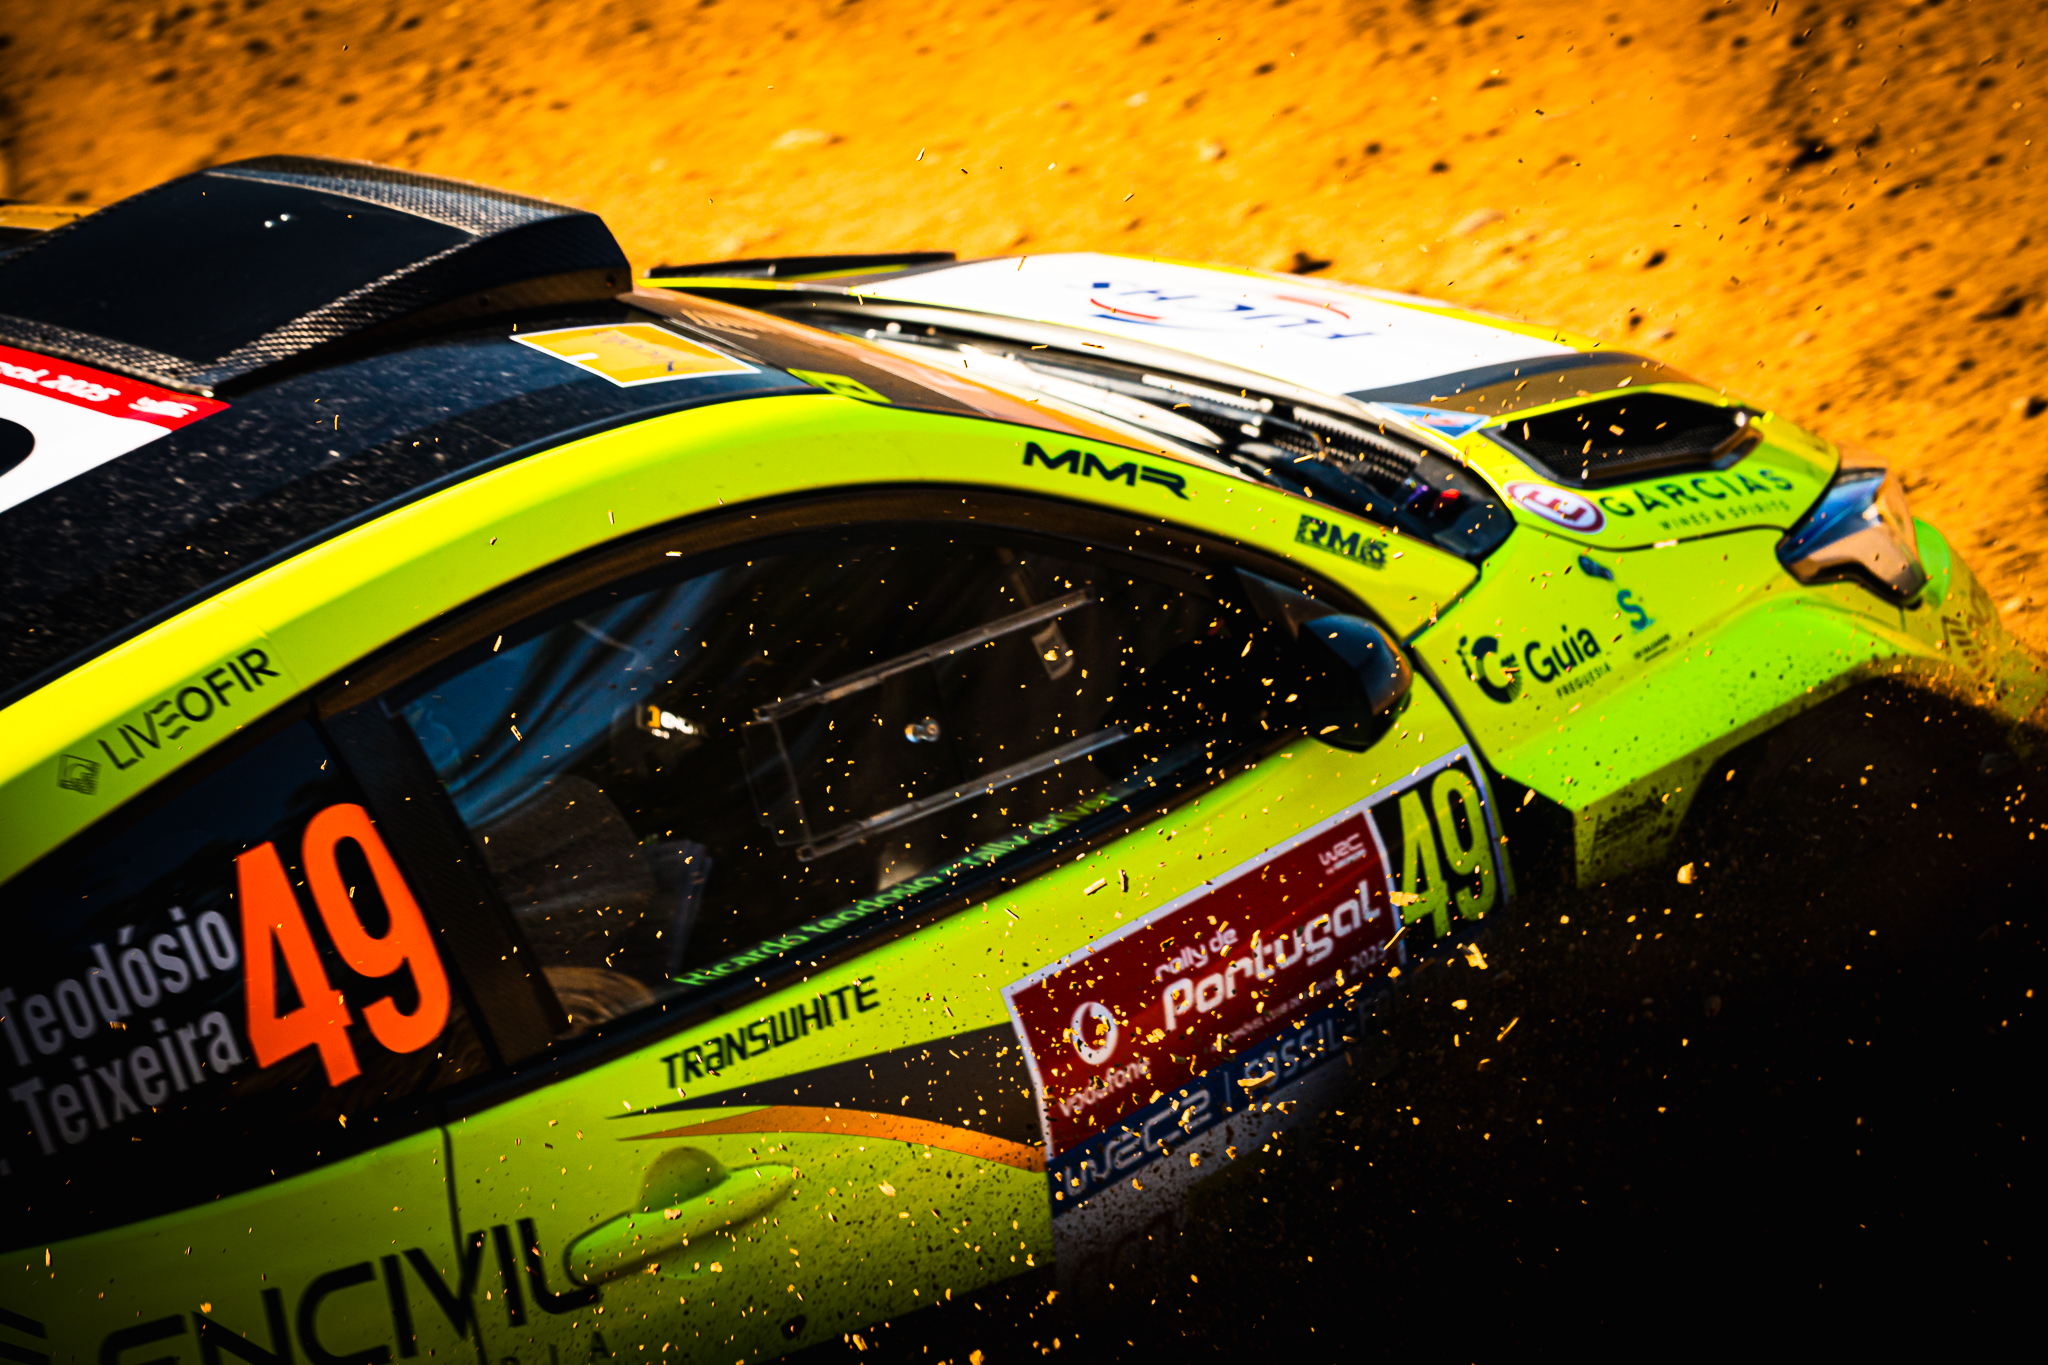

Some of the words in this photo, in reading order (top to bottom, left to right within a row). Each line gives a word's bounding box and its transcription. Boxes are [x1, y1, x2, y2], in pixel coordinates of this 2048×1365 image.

[1023, 441, 1190, 500] MMR
[1599, 469, 1794, 517] GARCIAS
[96, 648, 281, 771] LIVEOFIR
[1524, 624, 1601, 684] Guia
[1399, 768, 1497, 939] 49
[0, 904, 239, 1068] Teodósio
[236, 802, 451, 1087] 49
[1155, 944, 1210, 982] rally
[1209, 928, 1240, 954] de
[1162, 879, 1382, 1033] Portugal
[7, 1009, 245, 1156] Teixeira
[1057, 1057, 1151, 1118] vodafone
